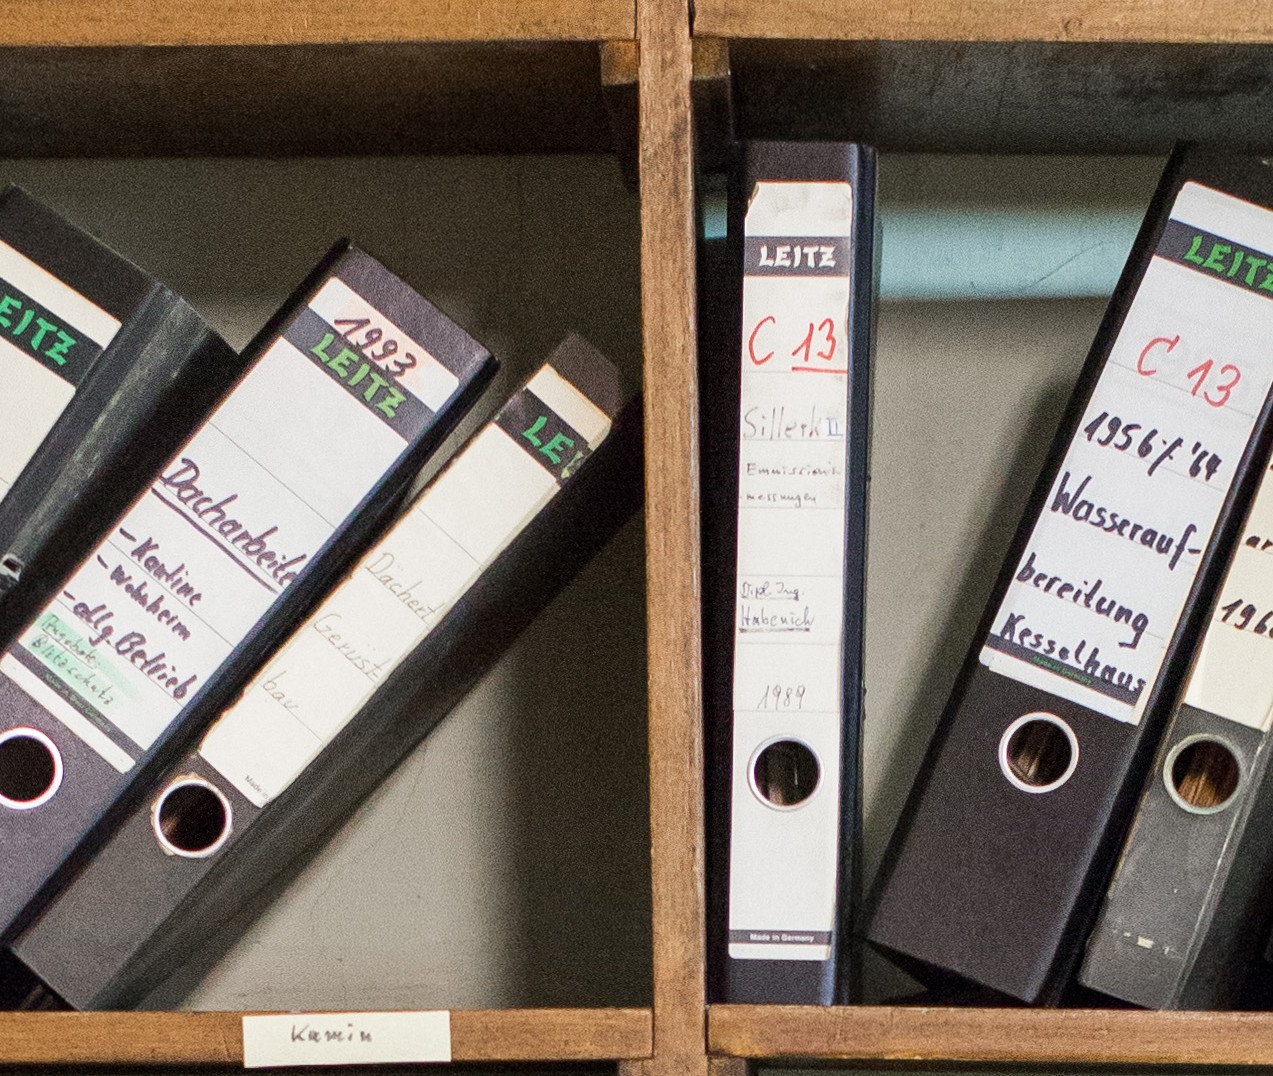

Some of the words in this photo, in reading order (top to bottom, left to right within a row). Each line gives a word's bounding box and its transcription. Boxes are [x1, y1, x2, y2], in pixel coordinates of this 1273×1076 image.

[759, 245, 836, 267] LEITZ
[334, 315, 420, 378] 1993
[748, 316, 776, 365] C
[792, 317, 837, 362] 13
[1137, 335, 1180, 377] C
[1187, 359, 1241, 409] 13
[310, 333, 408, 419] LEITZ
[1050, 470, 1203, 571] Wasserauf-
[1016, 552, 1149, 649] bereitung
[114, 632, 198, 703] Betrieb
[998, 612, 1147, 693] Kesselhaus
[757, 685, 806, 710] 1989
[749, 933, 770, 943] Made
[772, 933, 779, 943] in
[781, 933, 815, 945] Germany
[291, 1023, 372, 1043] Kamin
